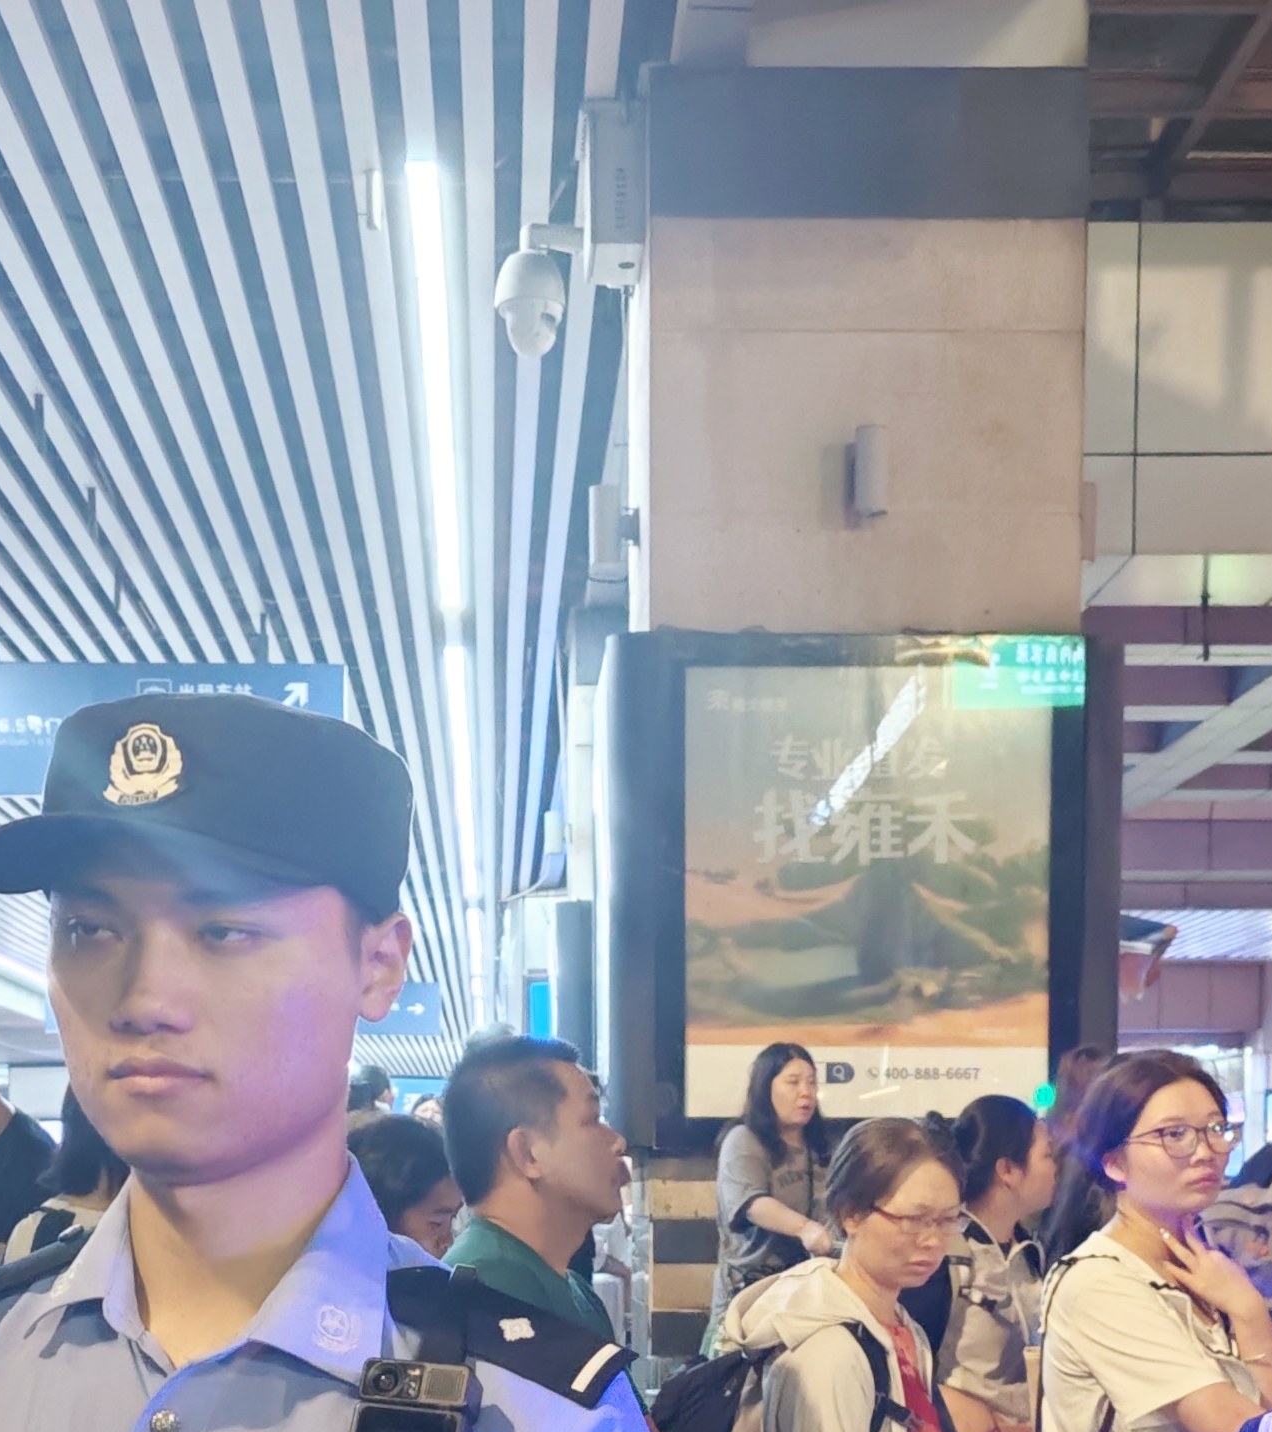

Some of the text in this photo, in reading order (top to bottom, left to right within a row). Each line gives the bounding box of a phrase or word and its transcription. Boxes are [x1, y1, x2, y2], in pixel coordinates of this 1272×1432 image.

[752, 787, 978, 867] 找雍禾
[884, 1067, 980, 1081] 400-888-6667
